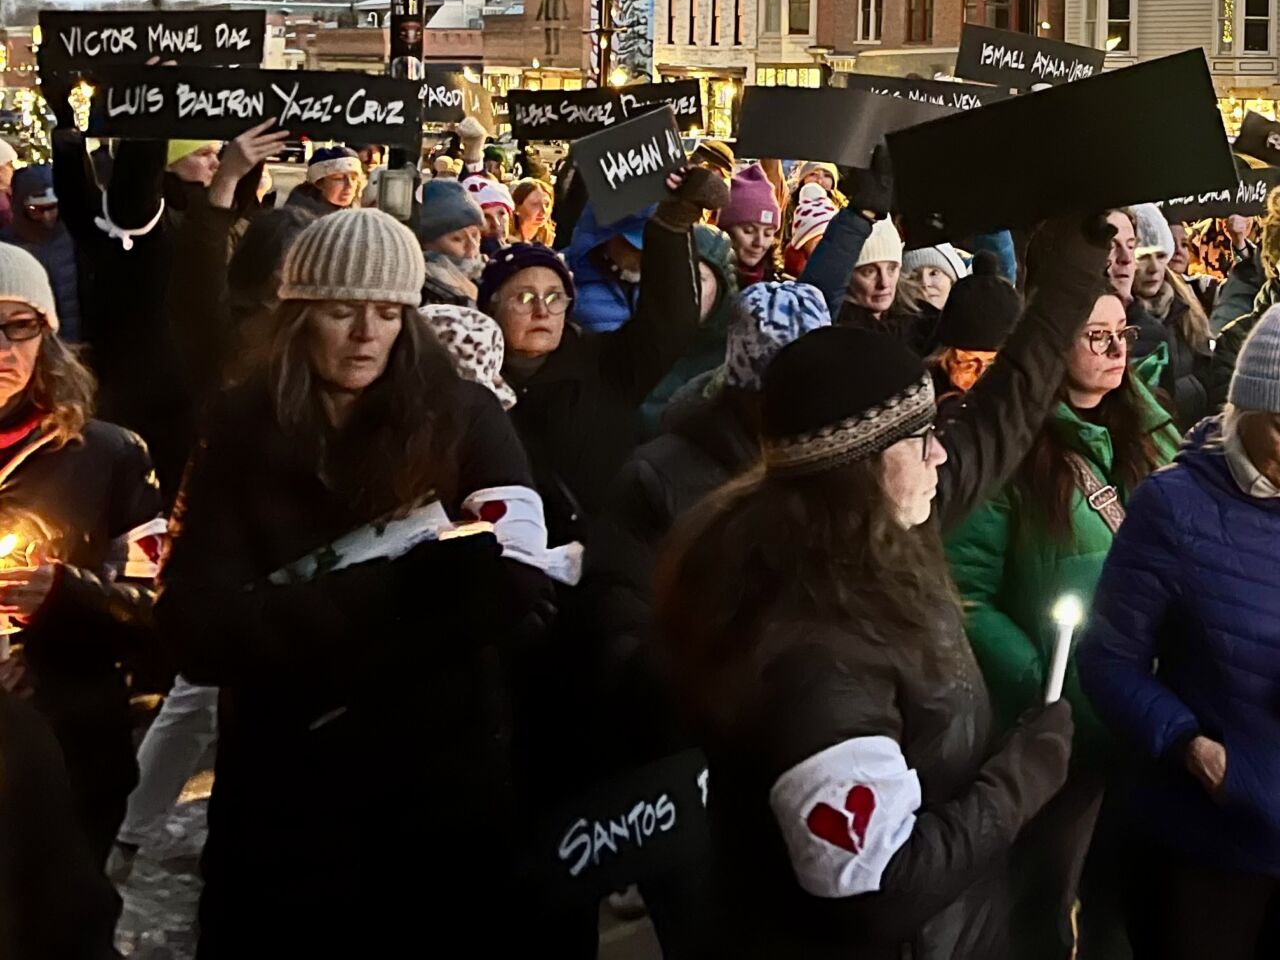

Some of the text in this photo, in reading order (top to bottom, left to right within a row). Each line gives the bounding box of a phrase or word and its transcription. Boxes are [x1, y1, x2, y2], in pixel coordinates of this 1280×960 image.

[60, 26, 138, 56] VICTOR
[148, 23, 202, 54] MANUEL
[981, 42, 1026, 69] ISMAEL
[107, 83, 165, 118] LUIS
[600, 135, 664, 190] HASAN
[1235, 179, 1267, 204] AVILES
[558, 793, 677, 877] SANTOS
